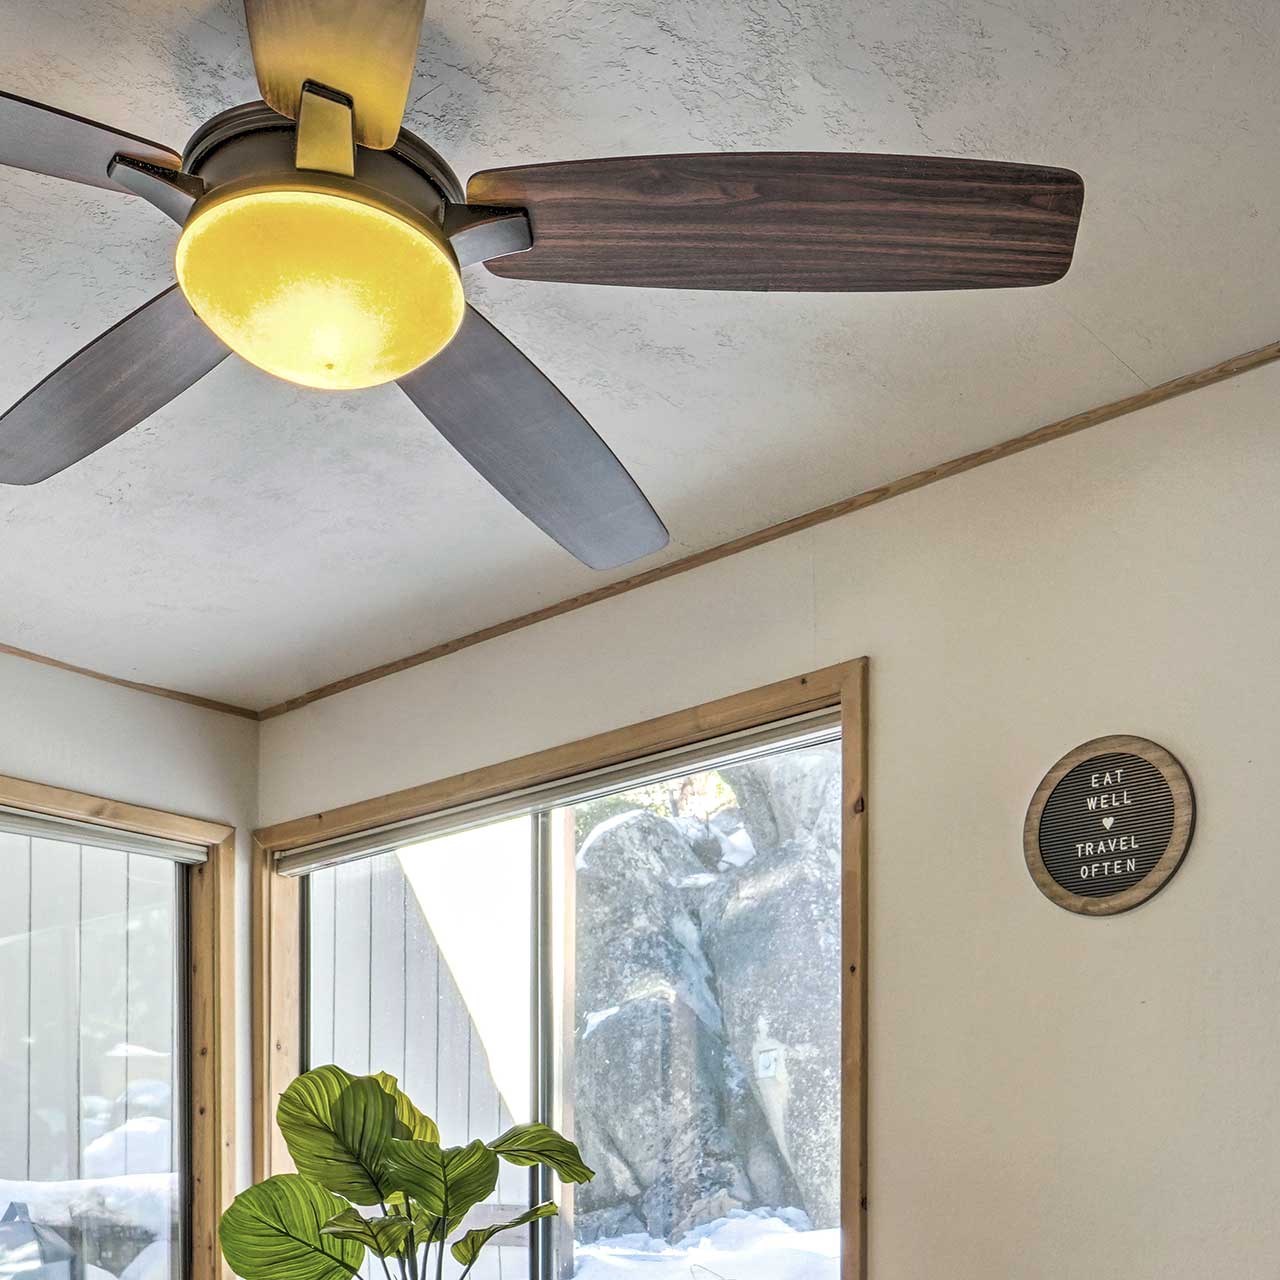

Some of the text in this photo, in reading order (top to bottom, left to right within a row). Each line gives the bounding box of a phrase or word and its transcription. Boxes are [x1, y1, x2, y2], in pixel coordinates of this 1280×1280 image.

[1091, 769, 1123, 787] EAT
[1086, 790, 1131, 810] WELL
[1075, 835, 1139, 858] TRAVEL
[1080, 858, 1136, 879] OFTEN
